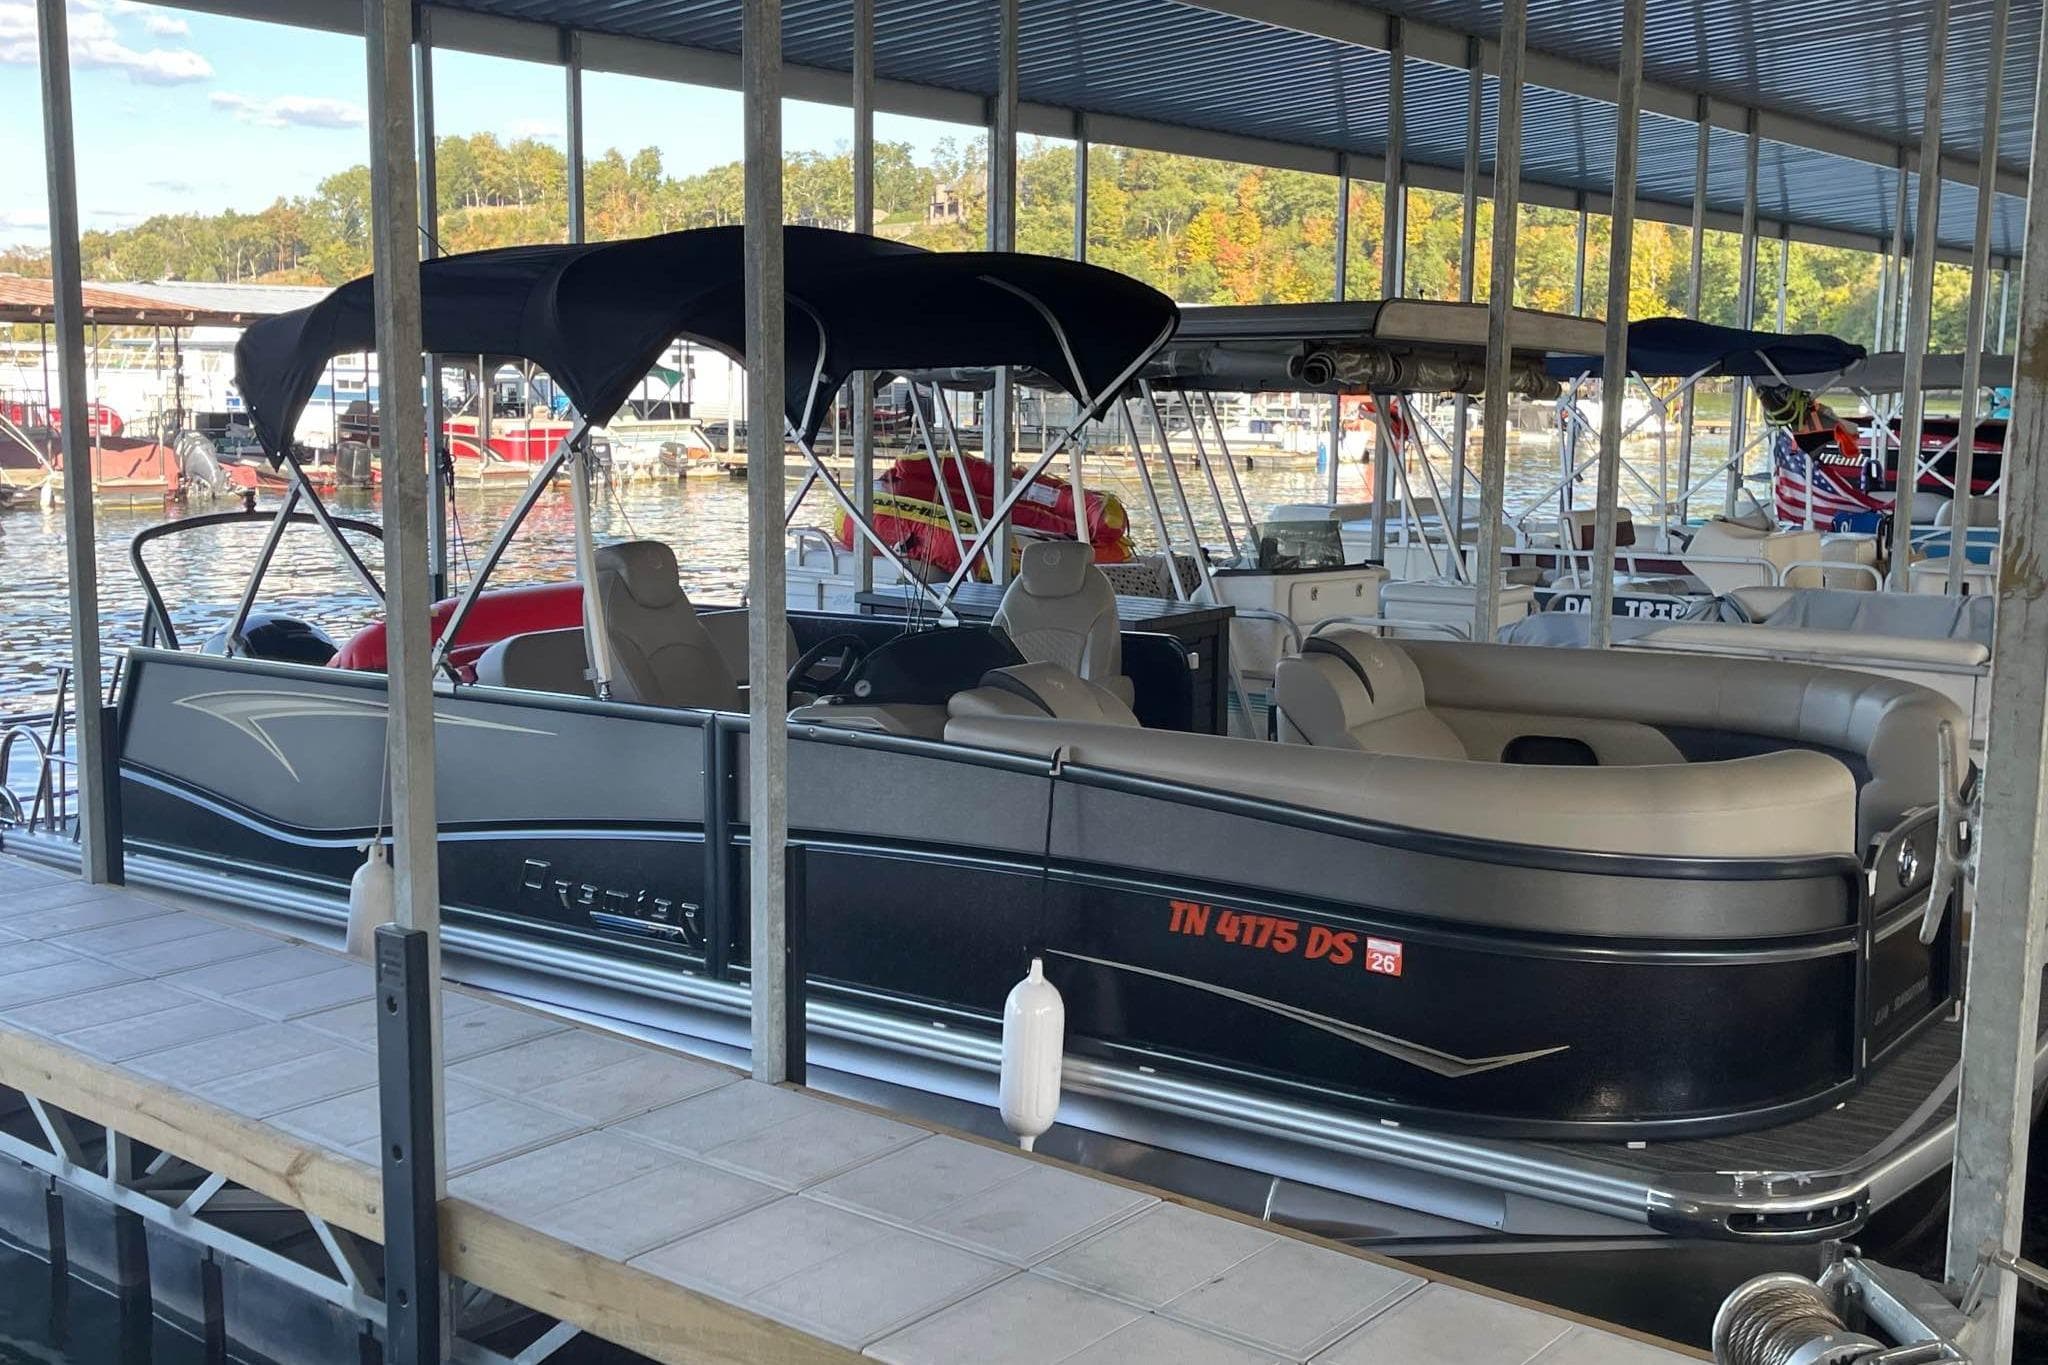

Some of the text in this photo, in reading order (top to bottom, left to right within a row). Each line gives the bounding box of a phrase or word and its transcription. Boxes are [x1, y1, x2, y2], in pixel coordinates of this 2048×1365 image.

[1169, 900, 1358, 965] TN 4175 DS
[1371, 952, 1395, 973] 26
